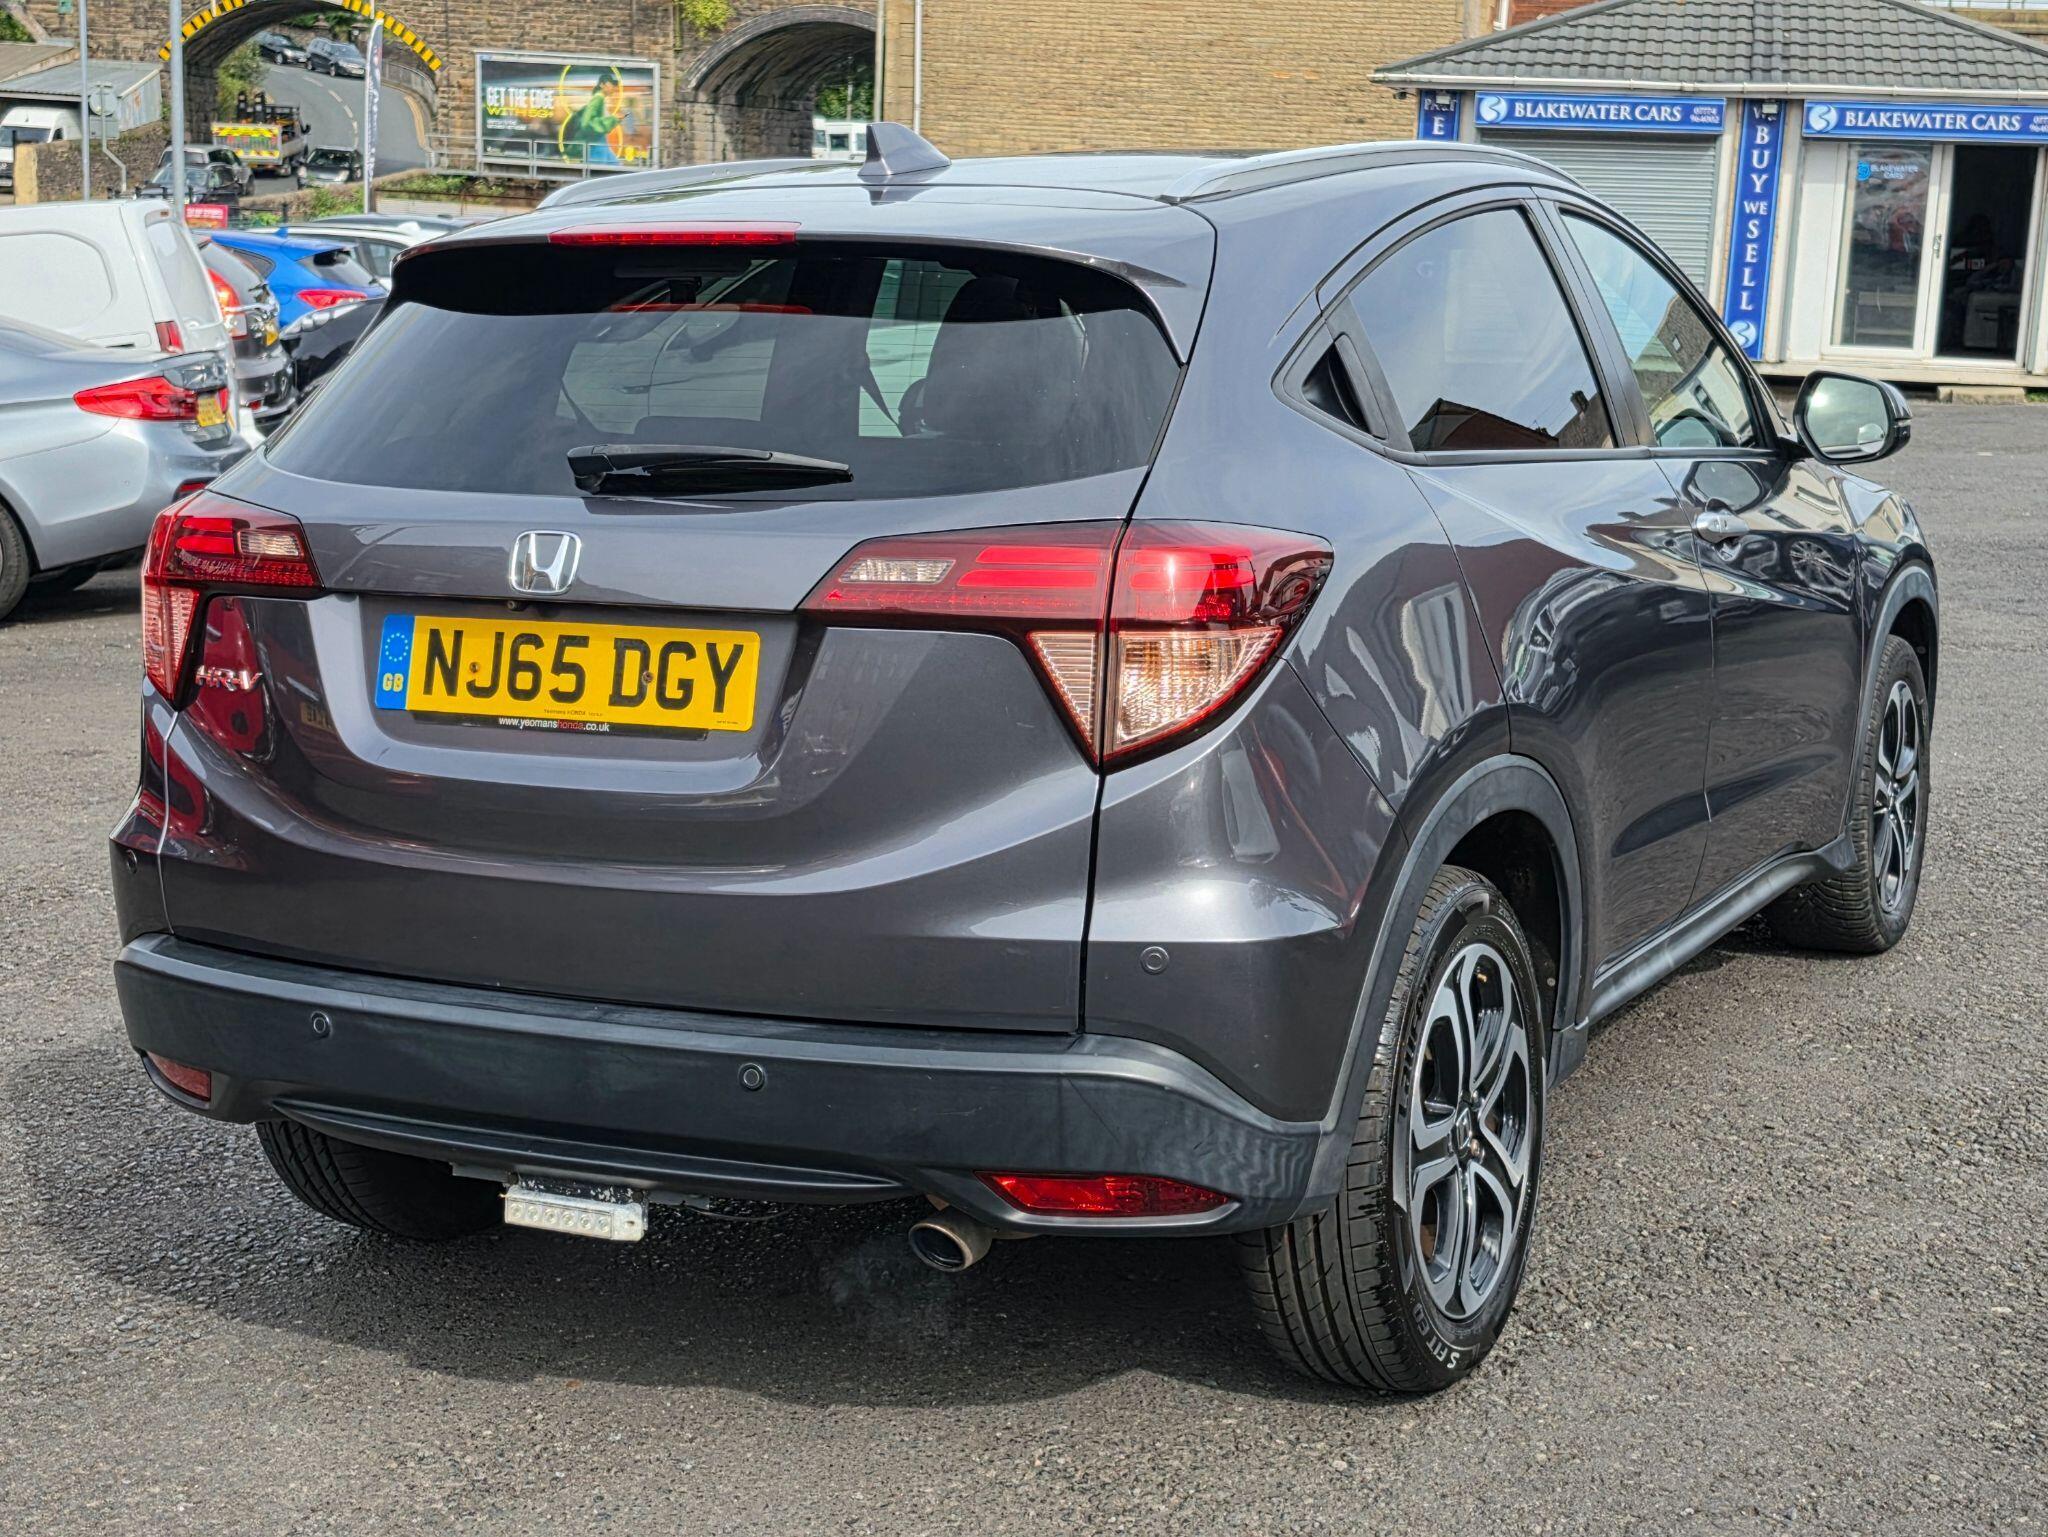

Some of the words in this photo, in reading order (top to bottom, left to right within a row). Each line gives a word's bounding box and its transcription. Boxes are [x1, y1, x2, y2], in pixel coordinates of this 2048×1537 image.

[487, 86, 505, 107] GET
[507, 88, 528, 108] THE
[529, 88, 555, 109] EDGE
[487, 107, 528, 116] WITH
[1514, 102, 1634, 121] BLAKEWATER
[1635, 105, 1682, 122] CARS
[1845, 111, 1969, 130] BLAKEWATER
[1972, 114, 2021, 131] CARS
[1871, 164, 1918, 173] BLAKEWATER
[1743, 201, 1768, 215] WE
[423, 628, 590, 704] NJ65
[608, 637, 744, 713] DGY
[382, 672, 404, 692] GB
[499, 714, 609, 732] www.yeomanshonda.co.uk
[1447, 1351, 1461, 1369] S
